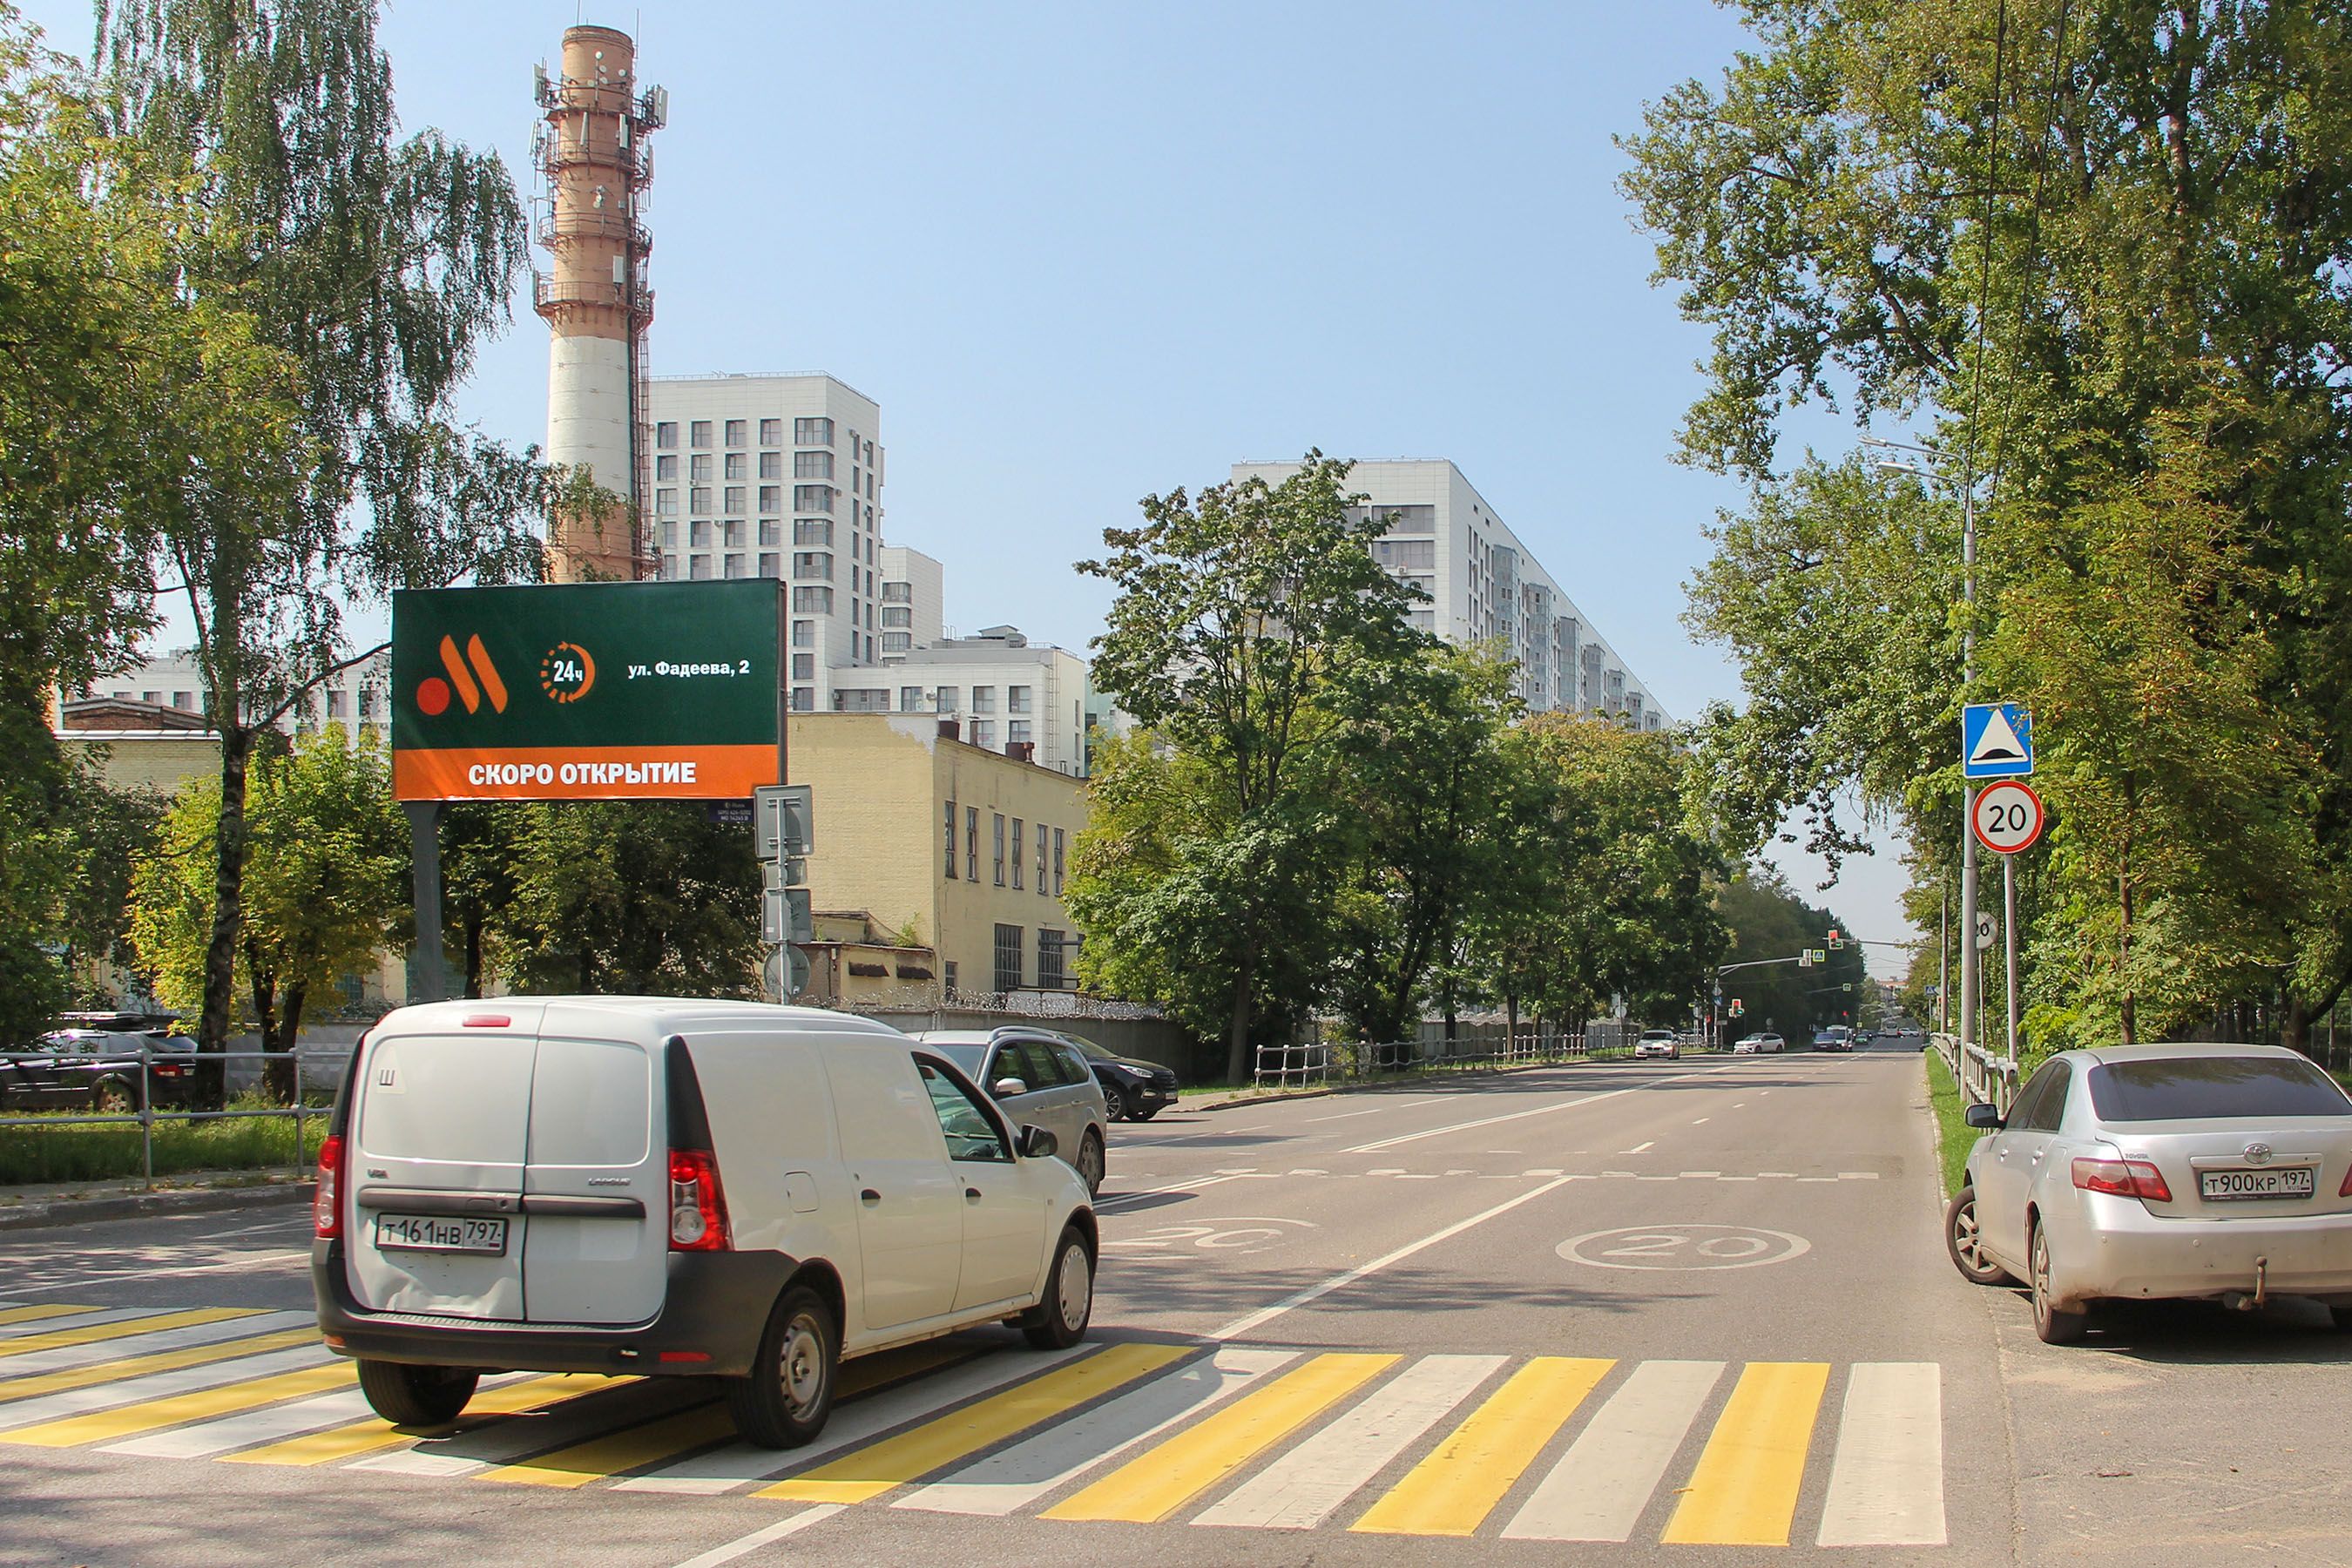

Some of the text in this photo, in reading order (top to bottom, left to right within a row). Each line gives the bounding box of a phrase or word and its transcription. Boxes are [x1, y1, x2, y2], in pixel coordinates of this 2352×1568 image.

[553, 660, 584, 682] 24ч
[627, 659, 750, 679] ул. Фадеева, 2
[469, 761, 697, 786] СКОРО ОТКРЫТИЕ
[1988, 803, 2027, 834] 20
[1976, 922, 1990, 937] 0
[2281, 1172, 2306, 1186] 197
[466, 1221, 499, 1240] 797
[1601, 1233, 1769, 1257] 20
